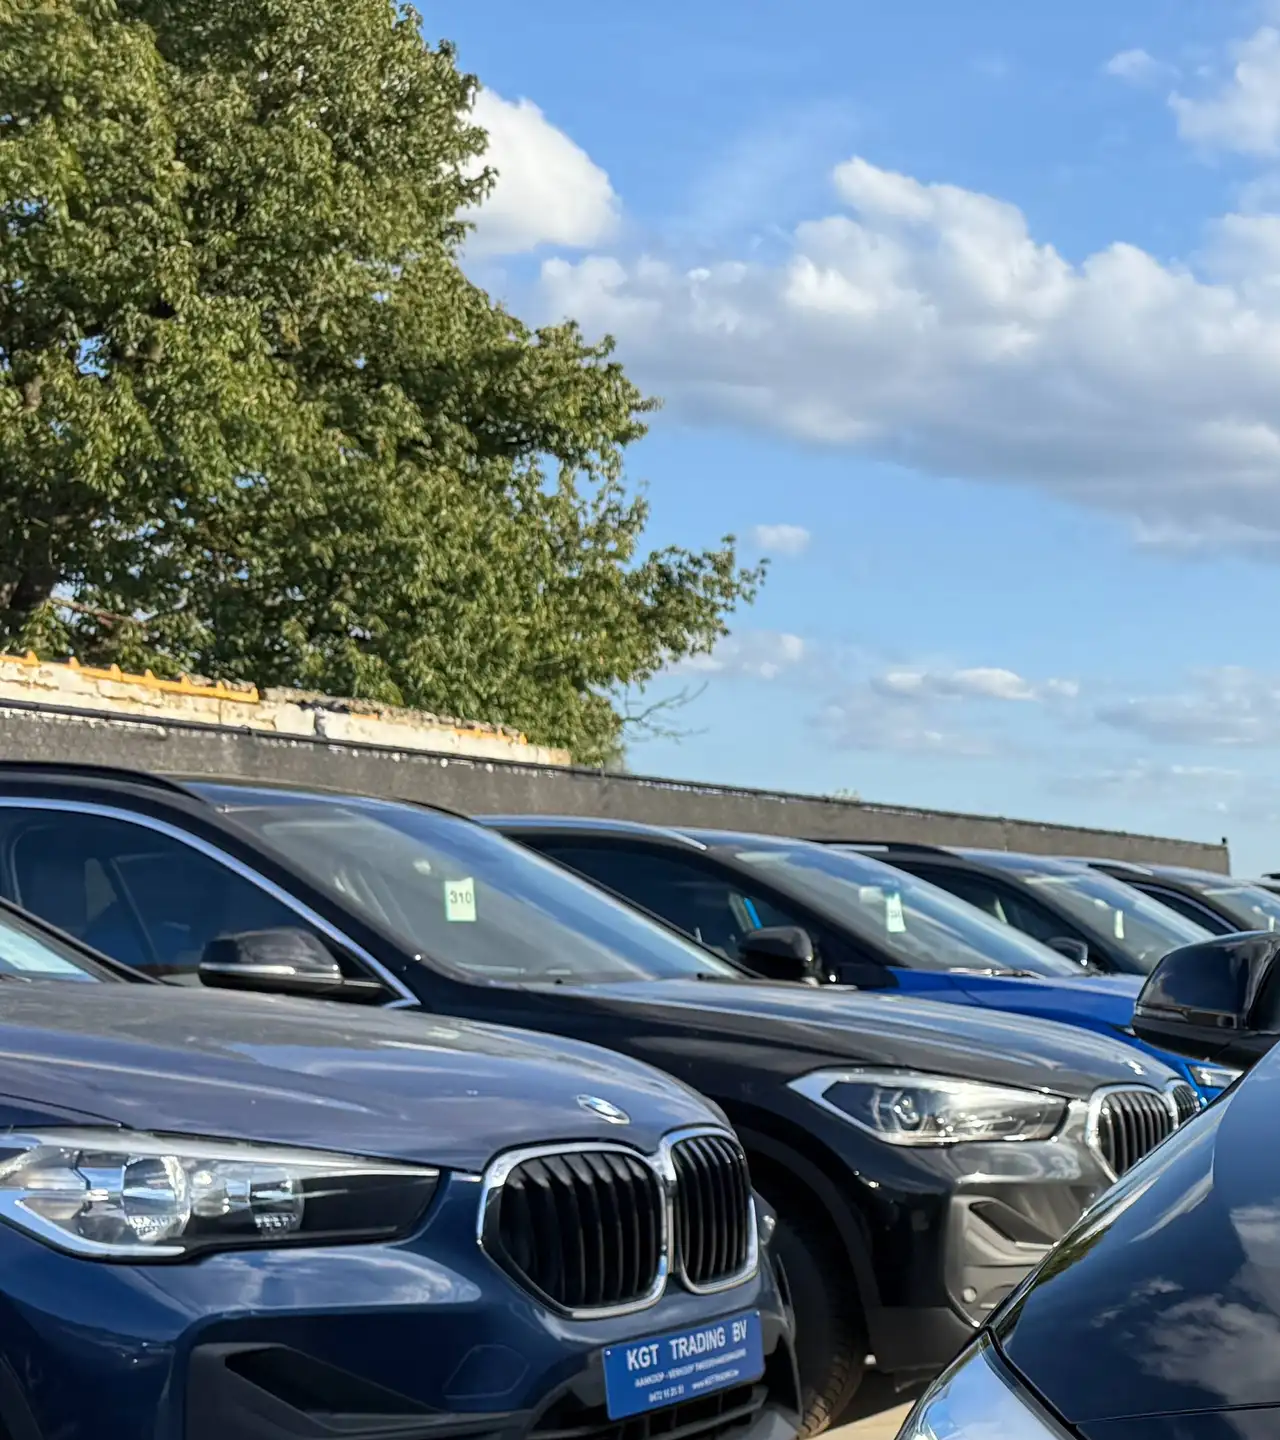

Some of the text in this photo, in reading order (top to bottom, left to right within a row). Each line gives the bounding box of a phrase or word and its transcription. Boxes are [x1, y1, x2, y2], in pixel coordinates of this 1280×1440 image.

[626, 1343, 659, 1371] KGT
[669, 1326, 726, 1360] TRADING
[732, 1319, 748, 1342] BV
